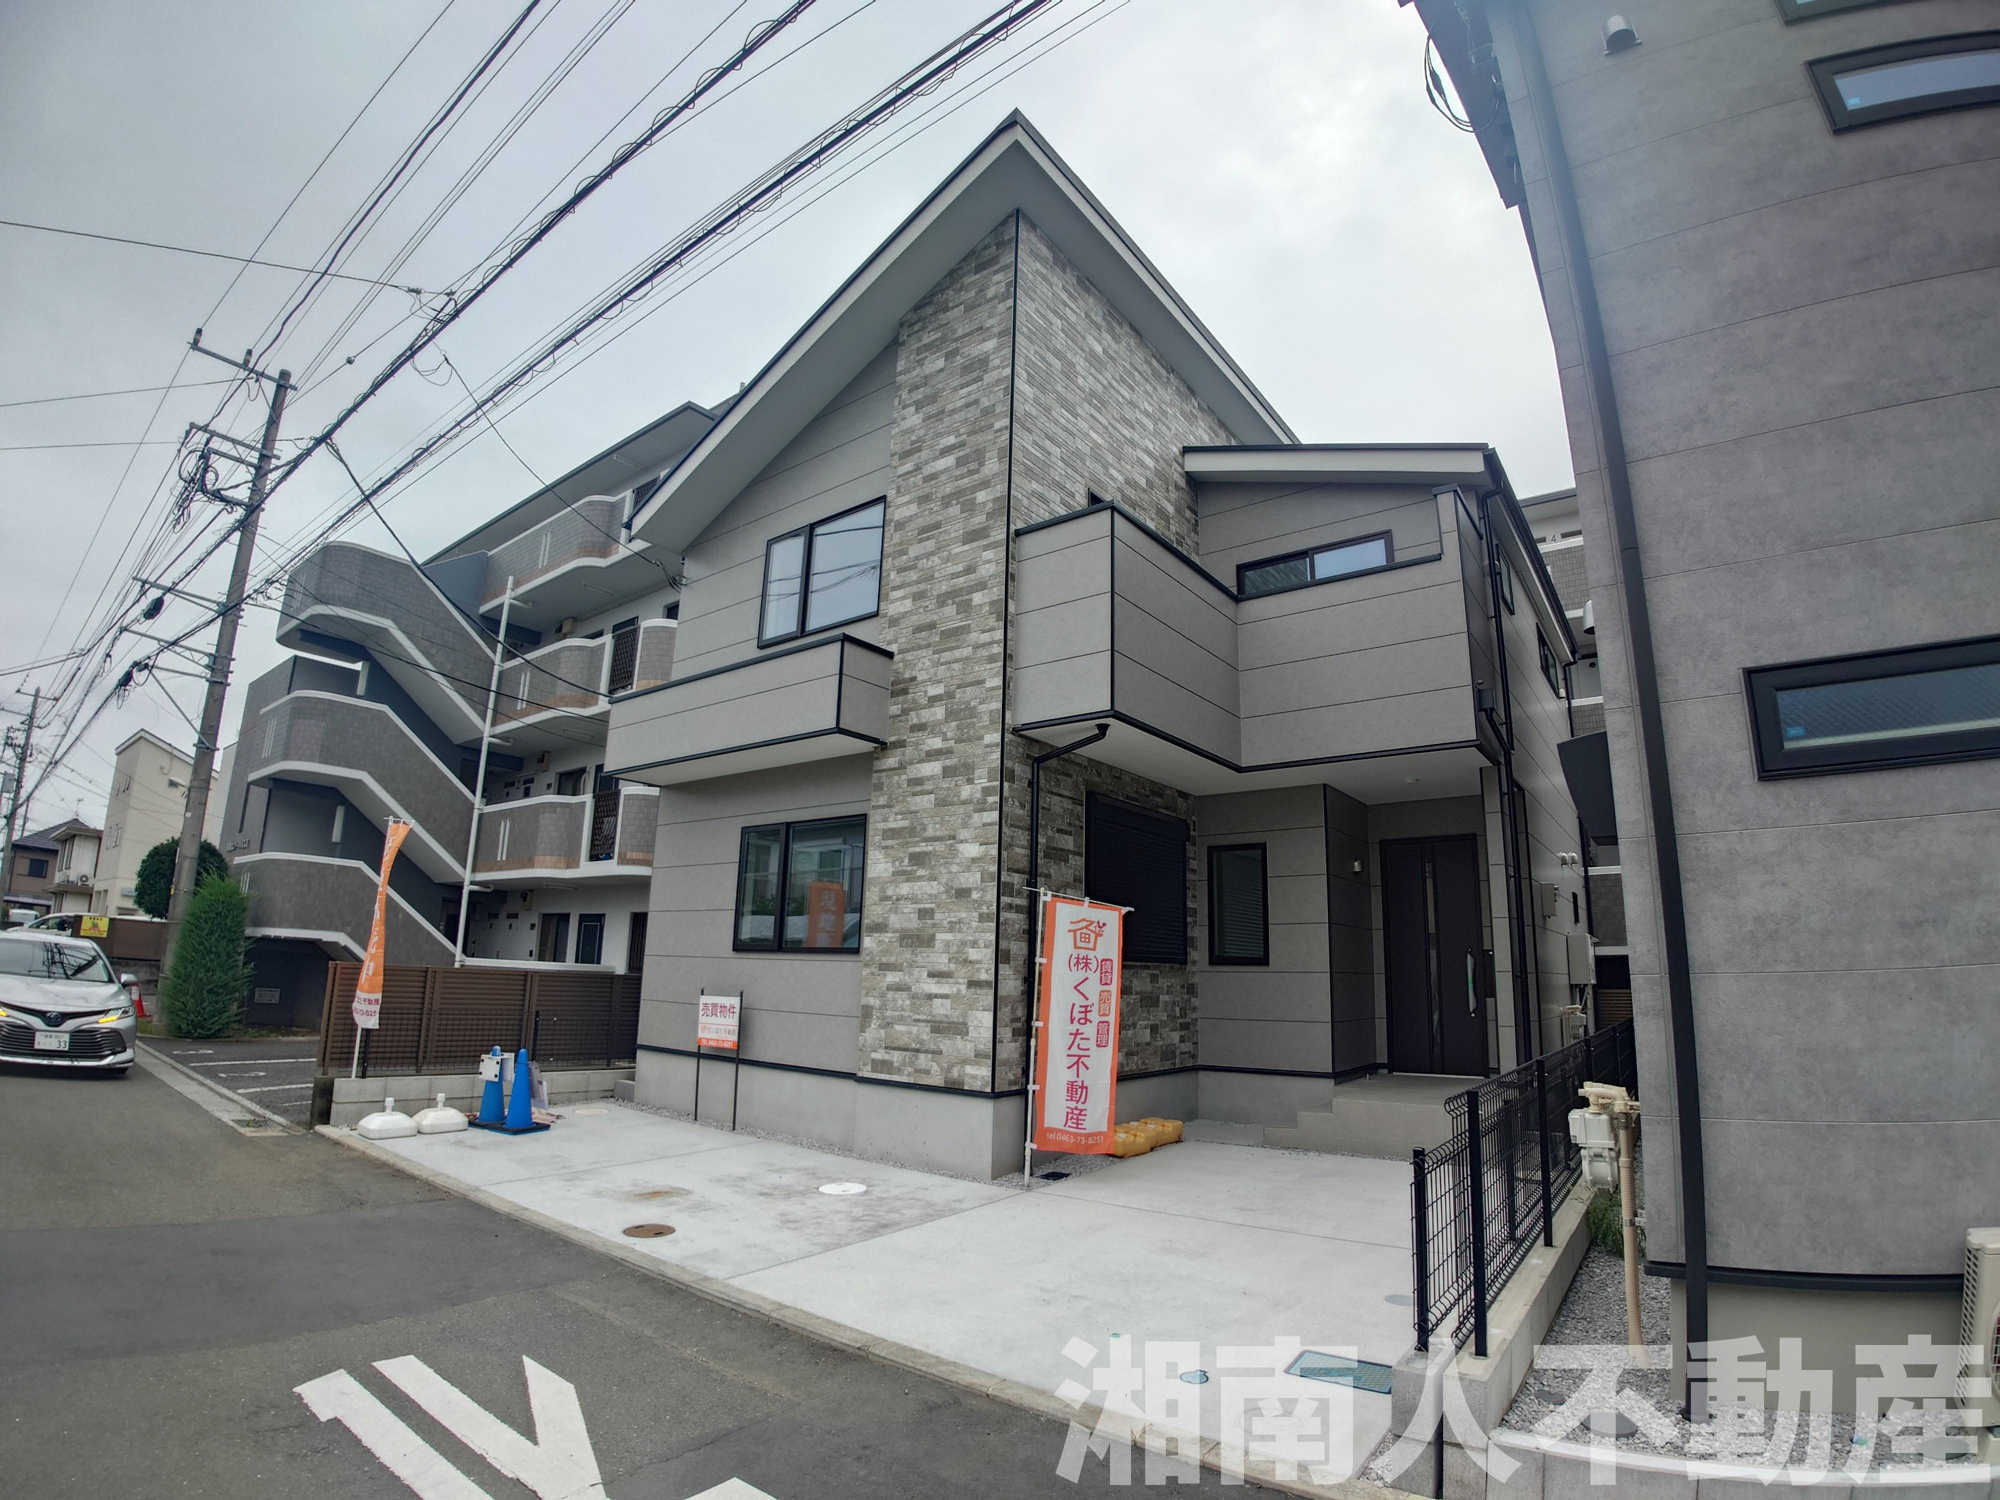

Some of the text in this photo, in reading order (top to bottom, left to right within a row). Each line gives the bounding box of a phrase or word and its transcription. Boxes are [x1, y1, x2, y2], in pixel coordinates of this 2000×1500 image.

[1100, 959, 1113, 985] 賃貸
[701, 1002, 737, 1019] 売買物件
[1099, 991, 1111, 1016] 売買
[56, 1040, 68, 1049] 33
[1063, 952, 1100, 1131] (株)くぼた不動産
[1096, 1022, 1109, 1046] 管理
